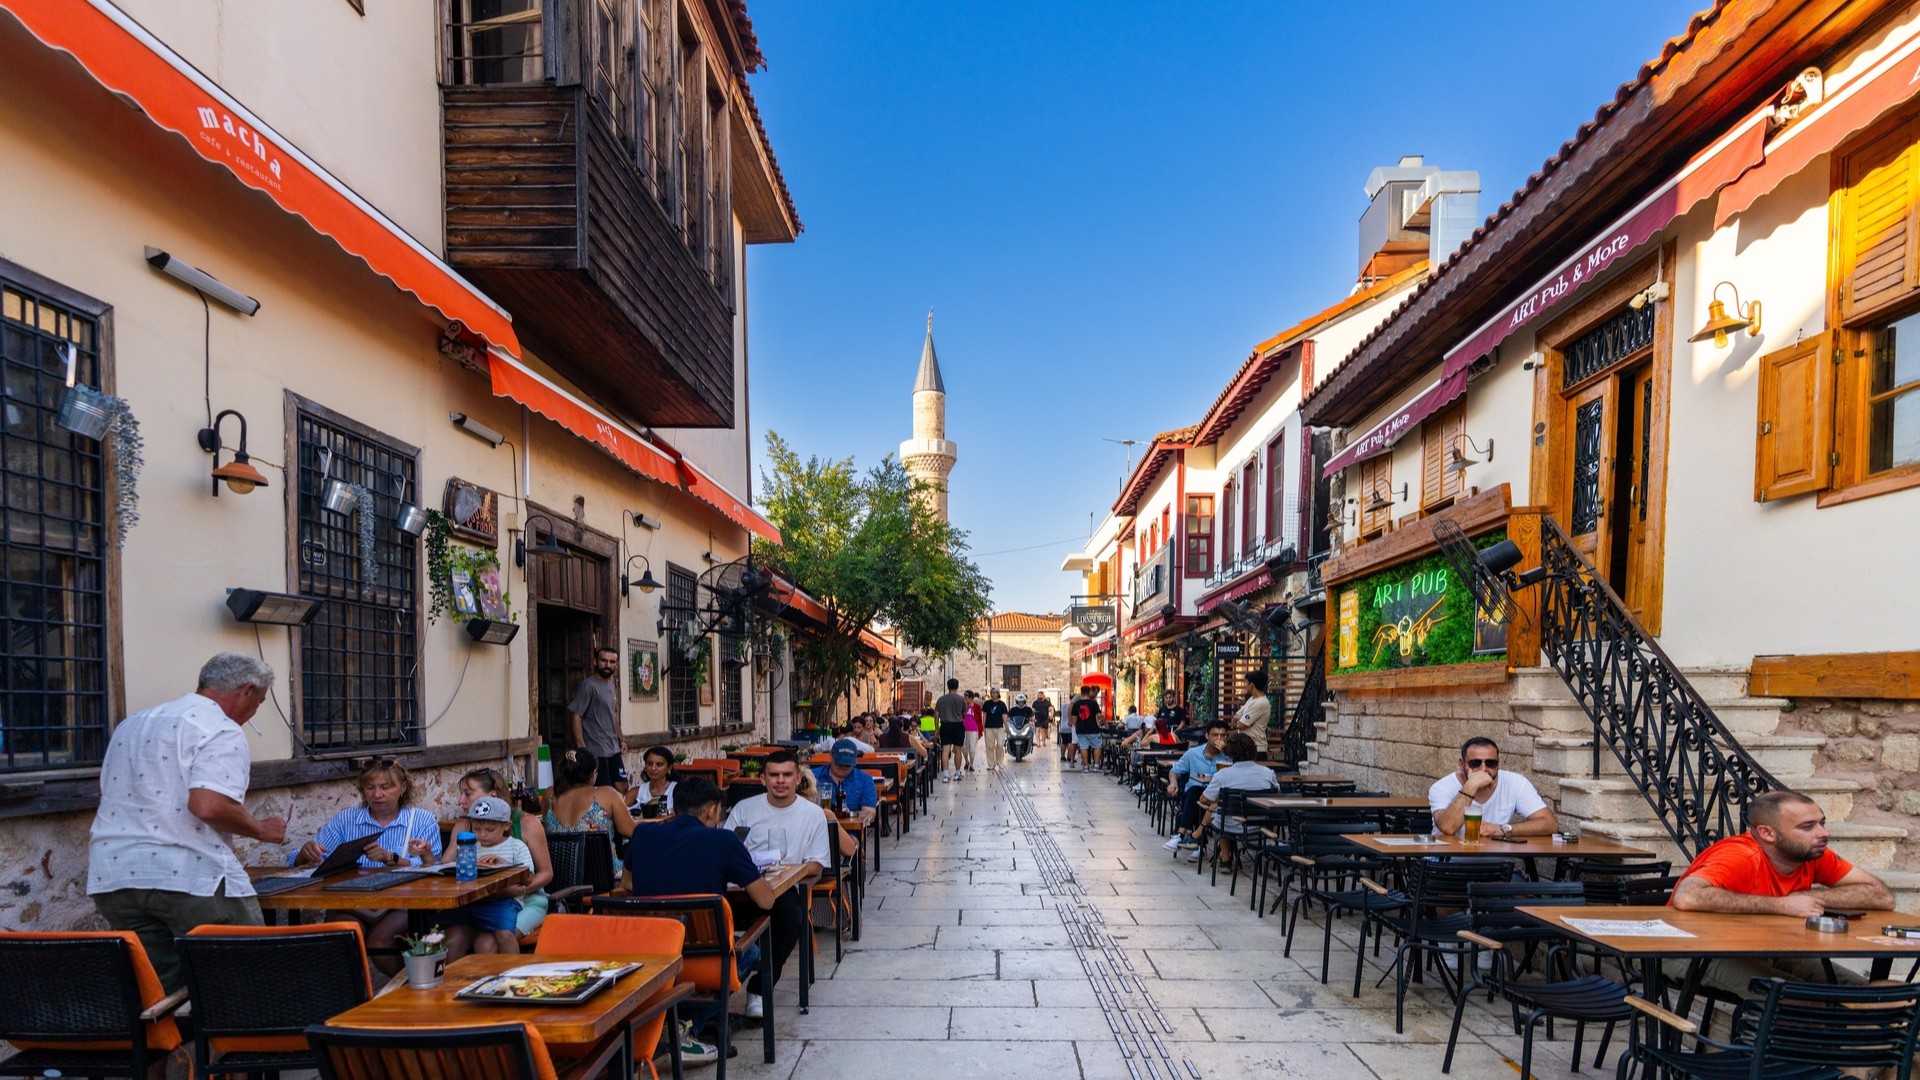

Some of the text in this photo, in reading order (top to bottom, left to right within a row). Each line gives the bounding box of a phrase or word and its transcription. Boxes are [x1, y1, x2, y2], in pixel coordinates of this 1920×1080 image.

[197, 106, 281, 180] macha
[200, 131, 221, 150] cafe
[235, 156, 282, 192] restaurant
[1509, 234, 1629, 328] ART Pub & More
[1354, 438, 1370, 458] ART
[1371, 429, 1384, 448] Pub
[1391, 413, 1410, 433] More
[476, 521, 494, 535] FOOD
[1341, 599, 1354, 610] HAPPY
[1373, 569, 1448, 608] ART PUB
[1076, 614, 1111, 624] EDINBURGH
[1217, 645, 1240, 653] TOBACCO
